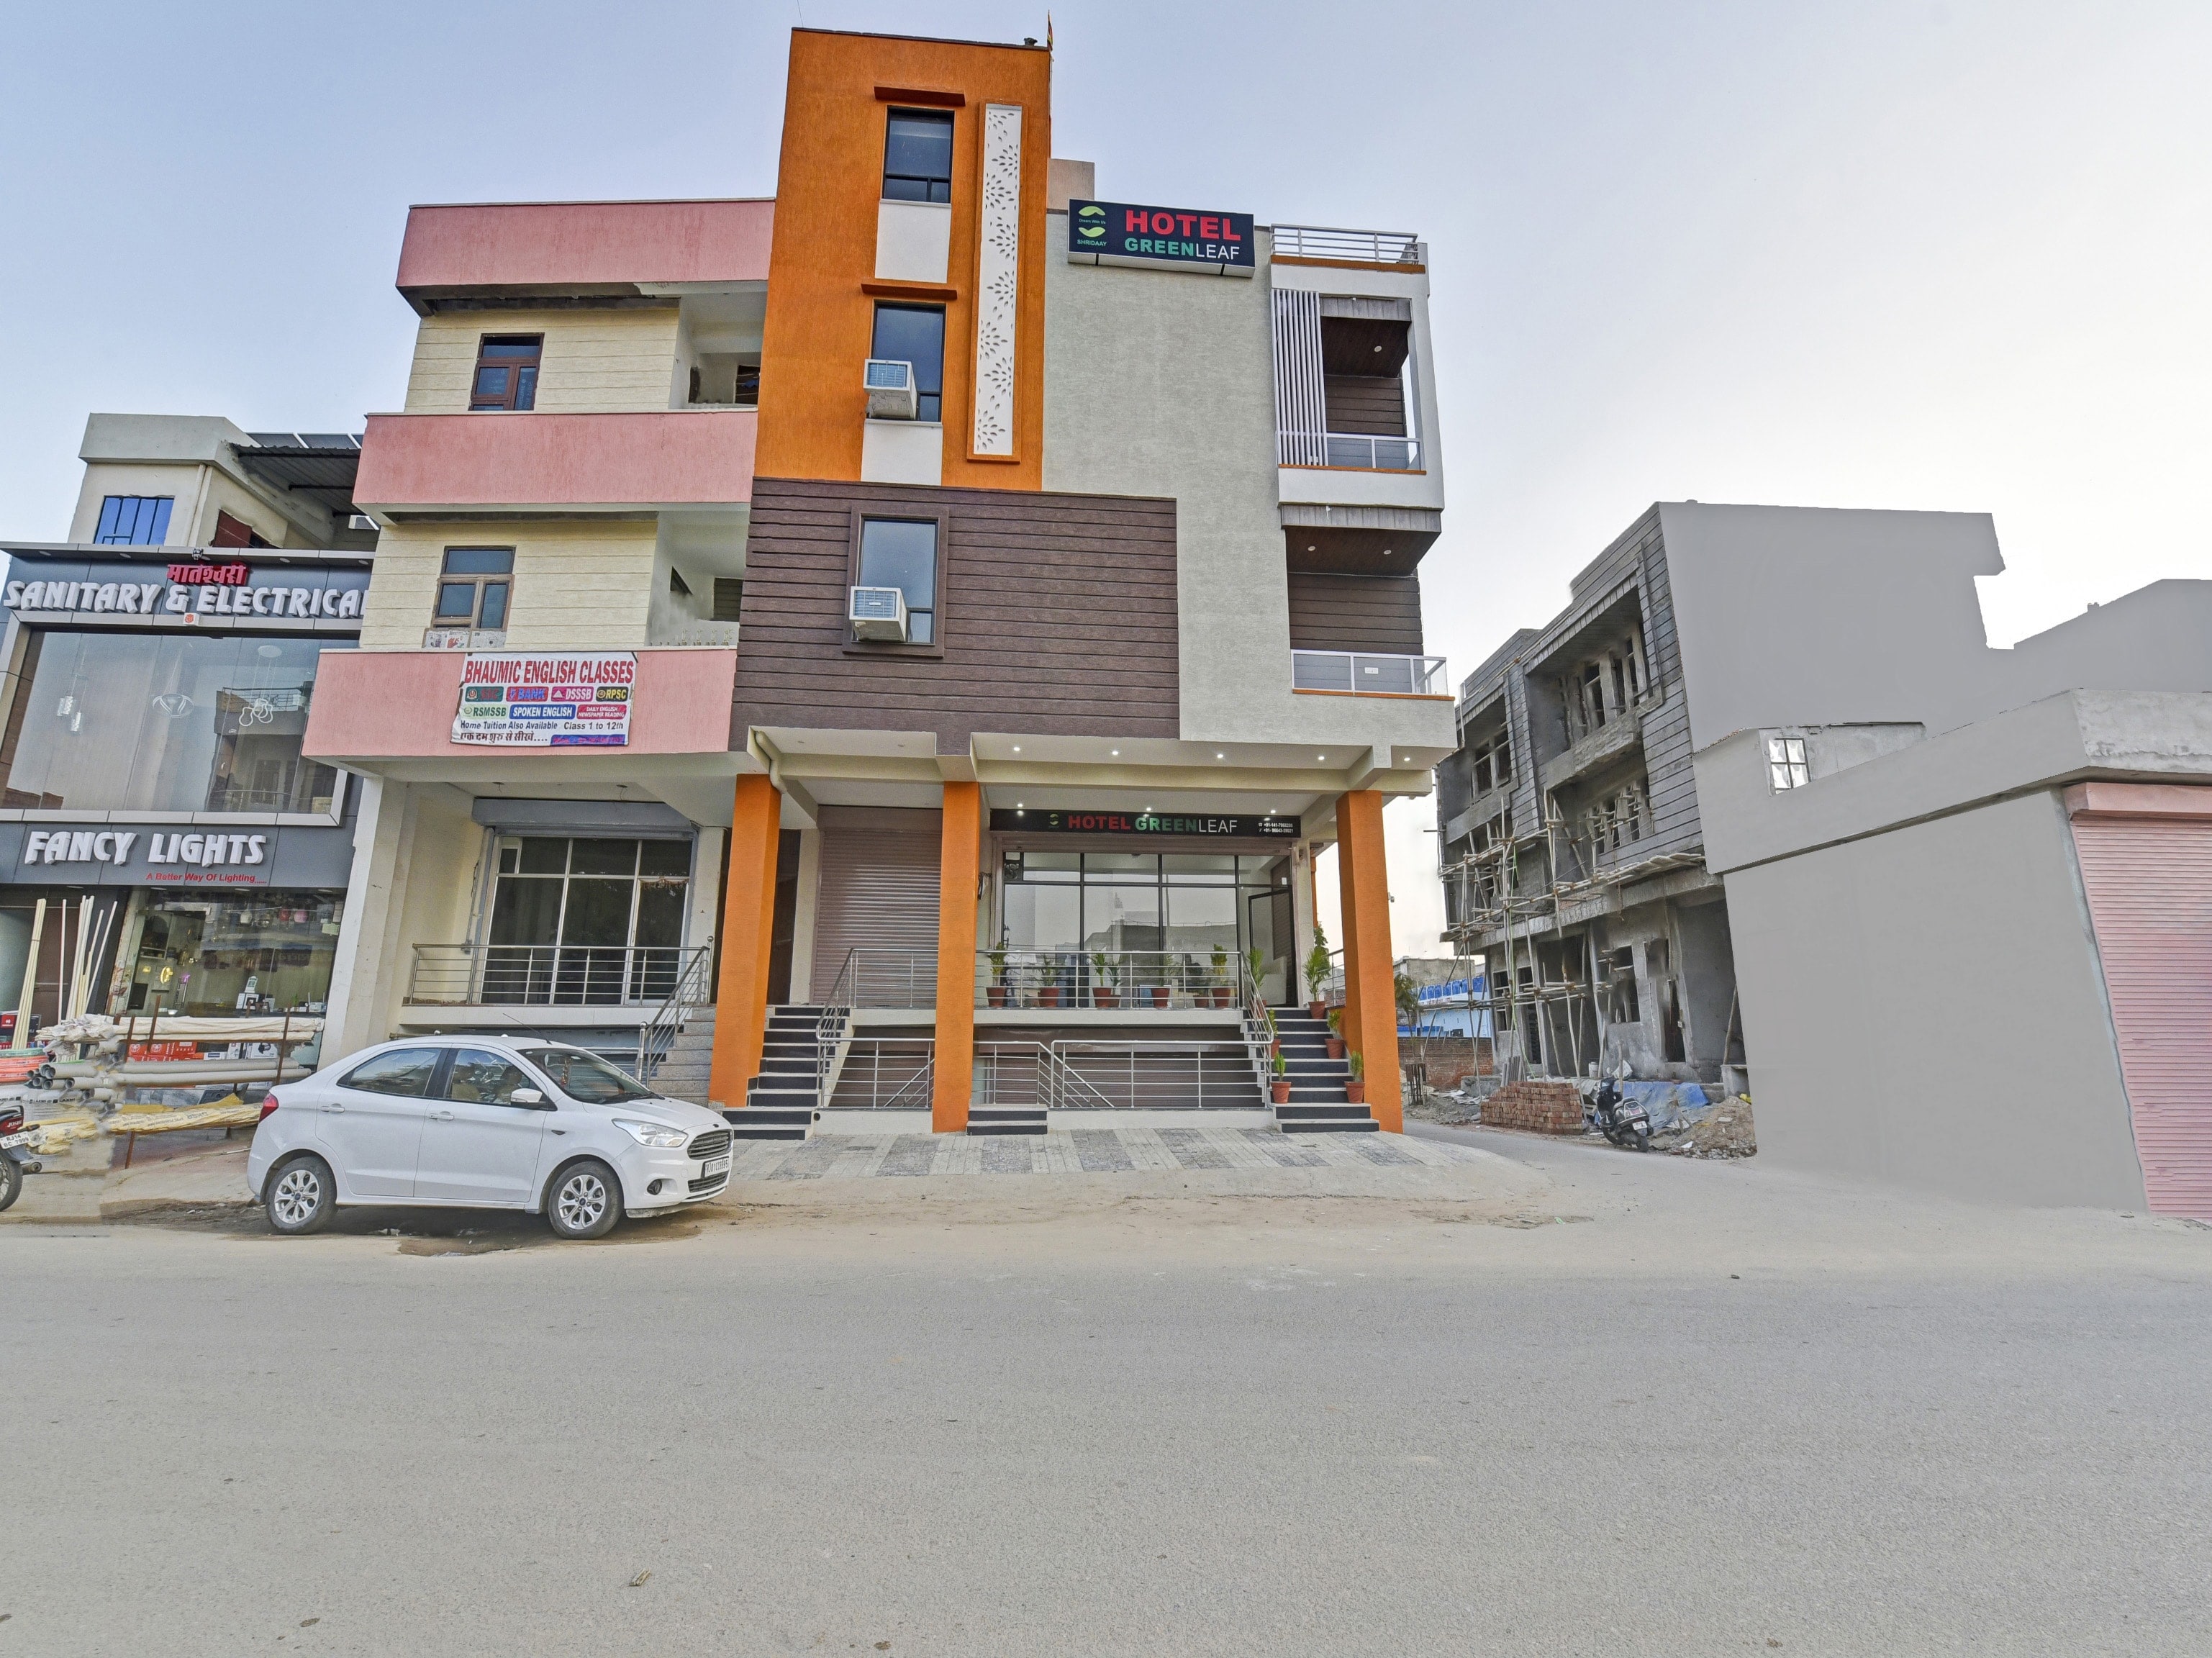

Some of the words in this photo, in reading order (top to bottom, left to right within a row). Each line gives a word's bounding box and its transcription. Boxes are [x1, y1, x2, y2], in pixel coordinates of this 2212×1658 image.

[1125, 209, 1241, 241] HOTEL
[1124, 237, 1240, 261] GREENLEAF
[3, 580, 162, 614] SANITARY
[166, 584, 190, 613] &
[464, 660, 522, 684] BHAUMIC
[523, 660, 577, 684] ENGLISH
[579, 660, 634, 684] CLASSES
[517, 688, 545, 699] BANK
[565, 688, 591, 700] DSSSB
[606, 689, 627, 699] RPSC
[473, 707, 507, 717] RSMSSB
[512, 707, 540, 717] SPOKEN
[542, 707, 572, 717] ENGLISH
[461, 720, 481, 729] Home
[525, 721, 558, 730] Available
[461, 733, 474, 741] एक
[476, 733, 488, 741] दम
[506, 730, 513, 740] से
[1068, 815, 1131, 830] HOTEL
[1135, 817, 1238, 833] GREENLEAF
[24, 830, 138, 866] FANCY
[147, 833, 266, 867] LIGHTS
[155, 872, 182, 881] Better
[185, 873, 204, 882] Way
